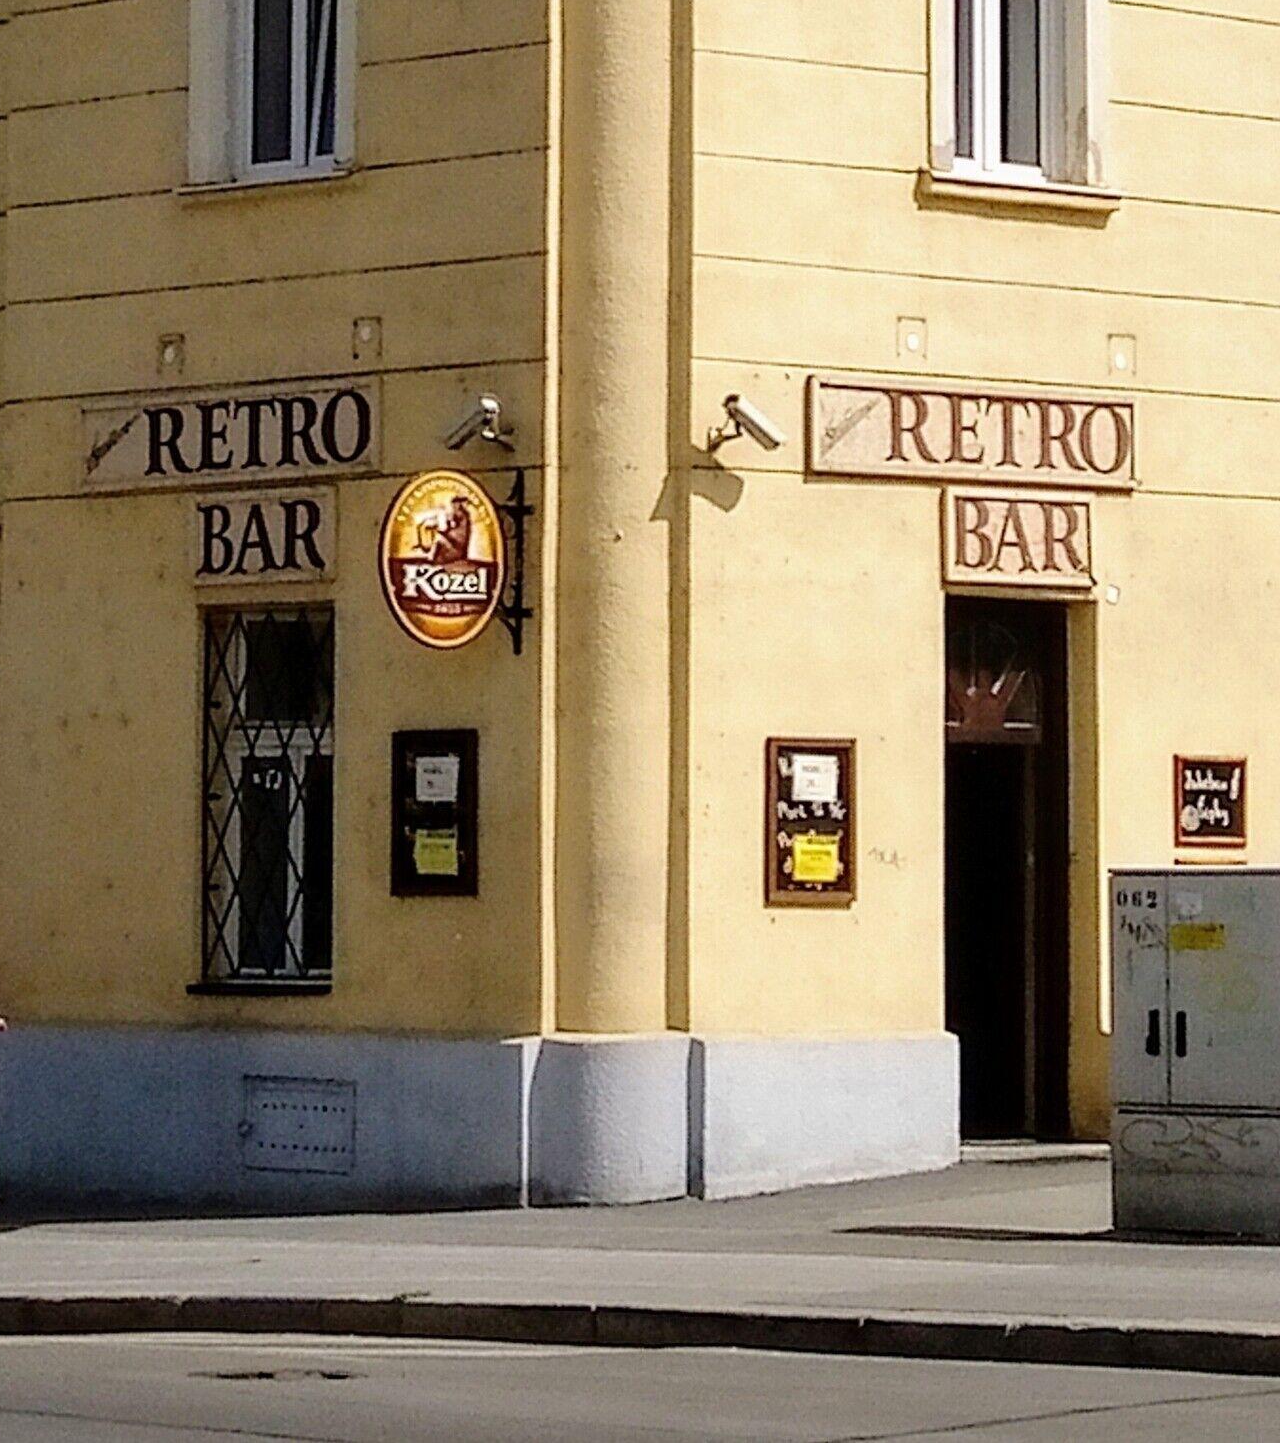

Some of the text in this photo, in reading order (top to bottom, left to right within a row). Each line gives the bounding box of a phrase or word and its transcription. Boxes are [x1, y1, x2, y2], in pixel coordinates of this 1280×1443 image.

[144, 390, 371, 476] RETRO
[885, 391, 1131, 474] RETRO
[195, 499, 326, 577] BAR
[955, 500, 1084, 574] BAR
[402, 564, 488, 601] Kozel
